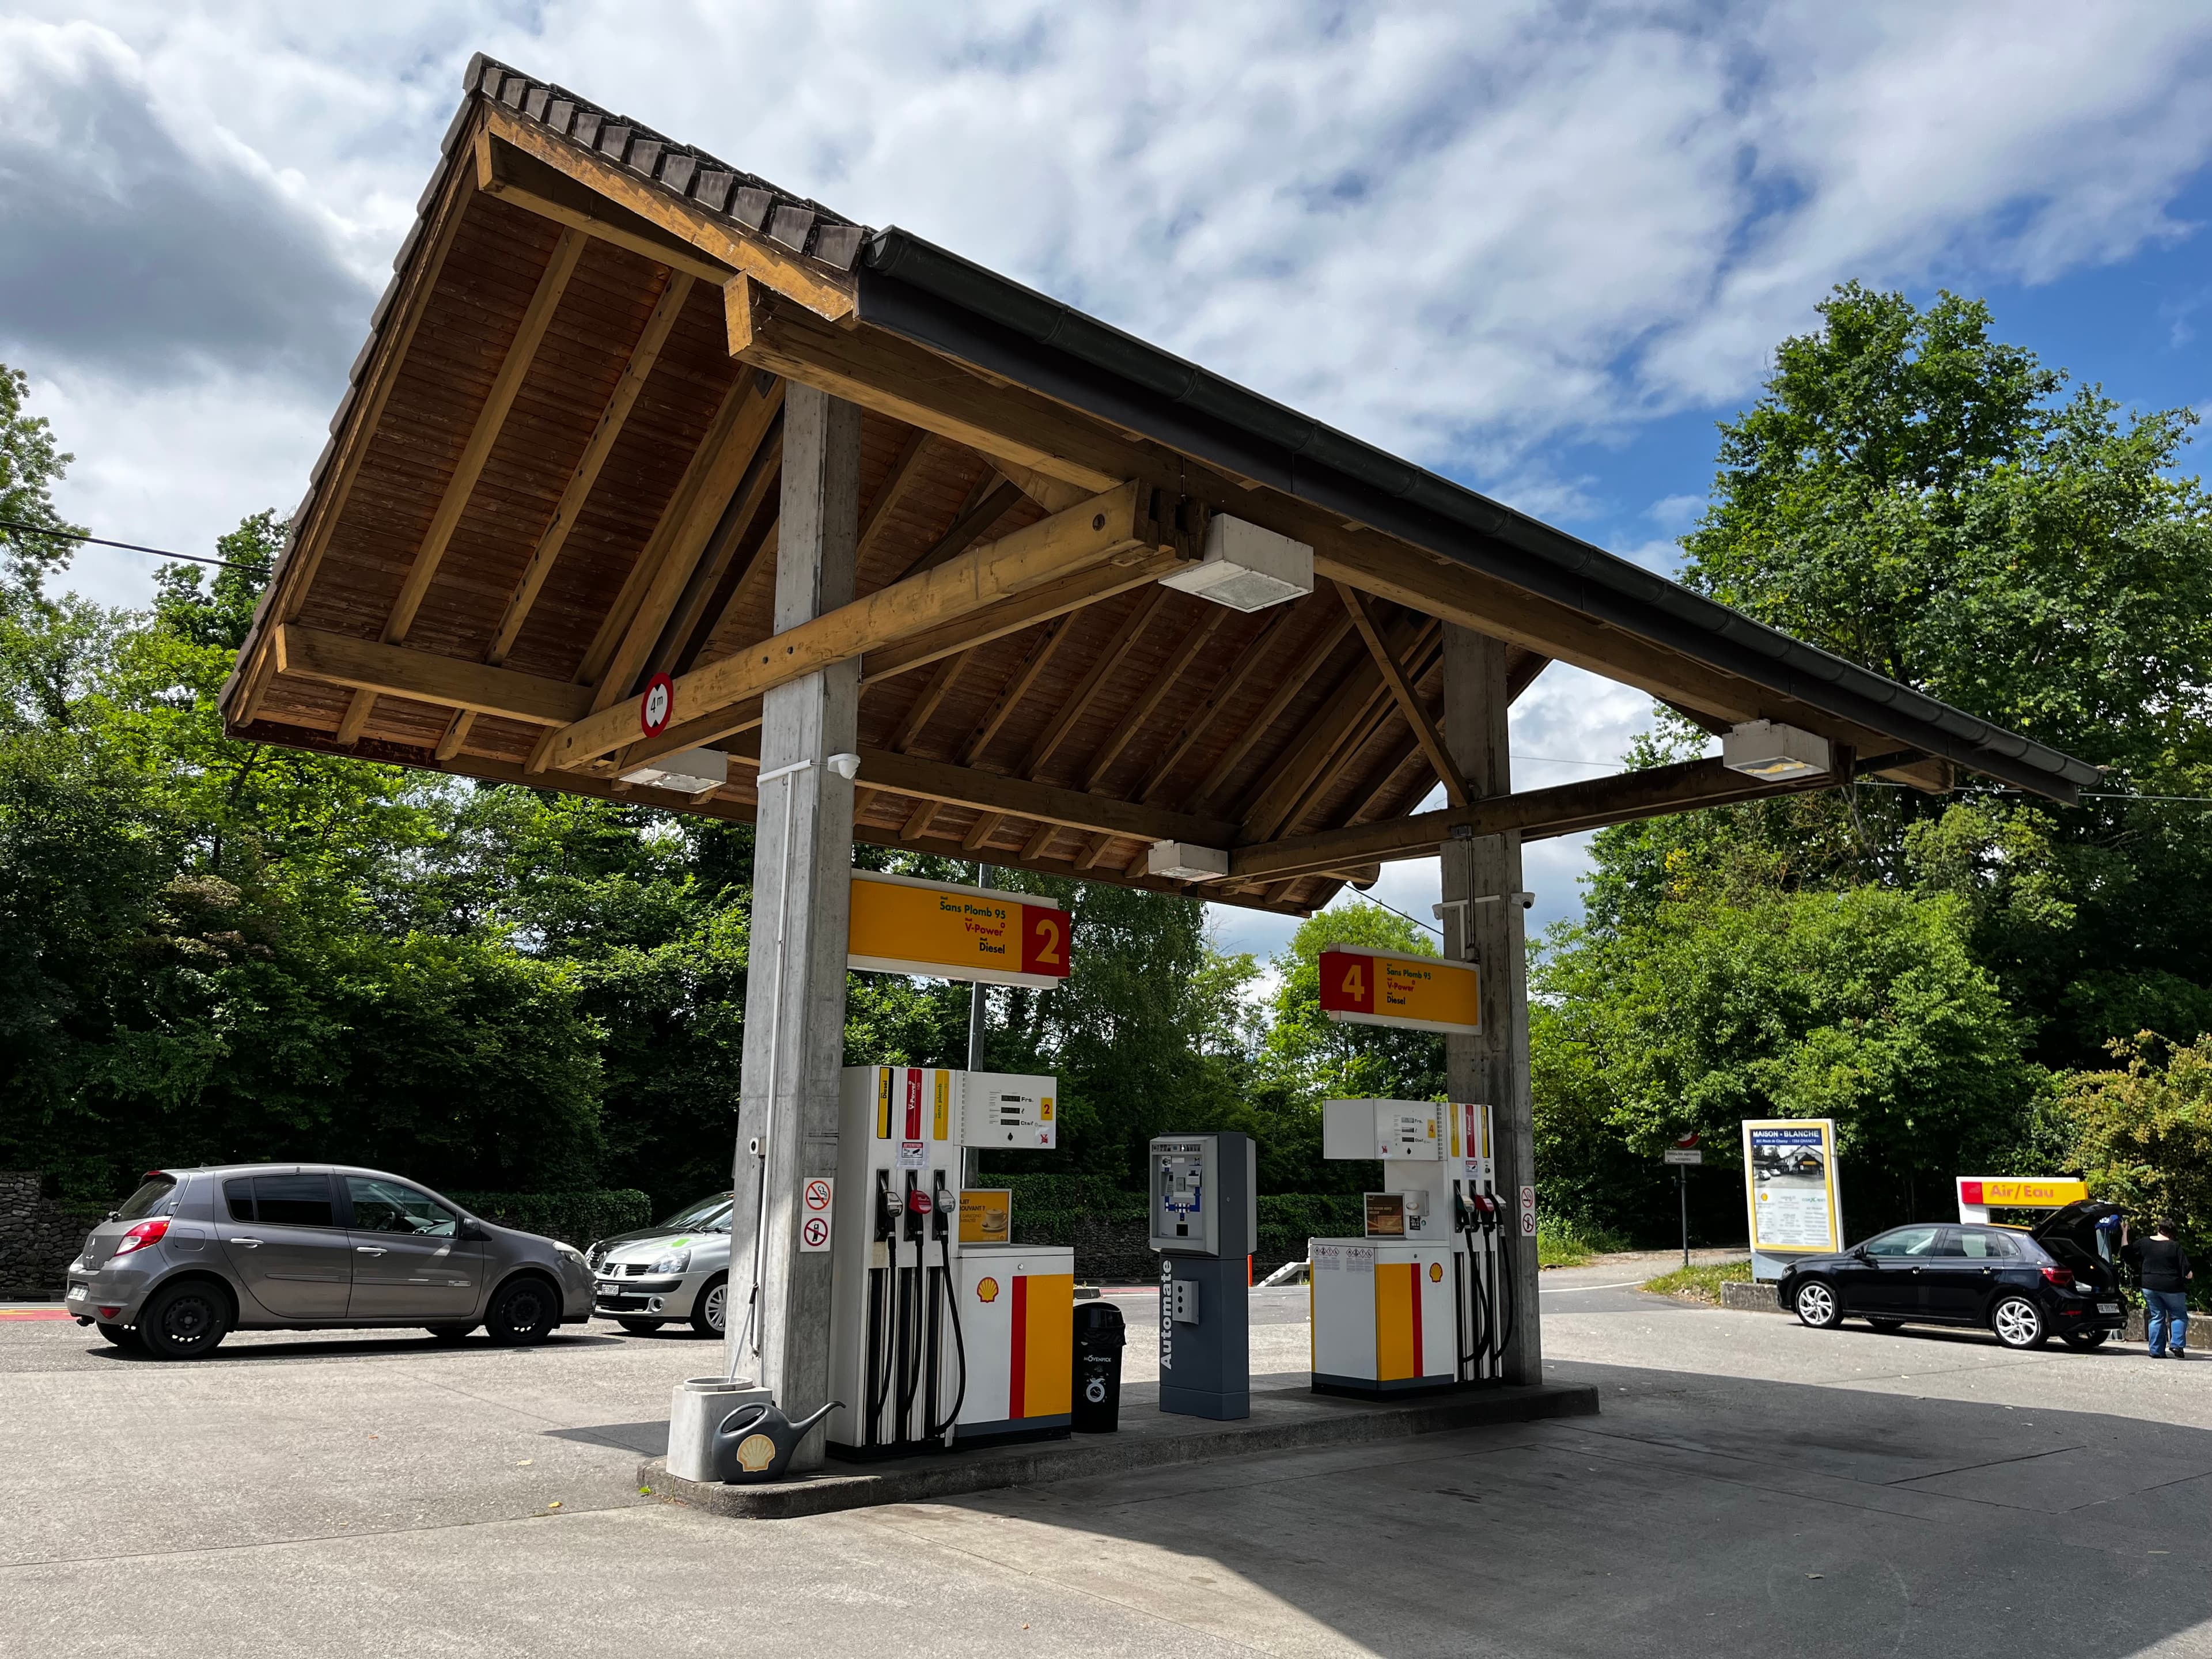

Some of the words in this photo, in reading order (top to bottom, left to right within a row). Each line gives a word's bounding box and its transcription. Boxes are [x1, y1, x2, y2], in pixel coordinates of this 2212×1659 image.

[940, 901, 961, 912] Sans
[964, 904, 992, 918] Plomb
[995, 909, 1006, 919] 95
[965, 923, 1003, 936] V-Power
[979, 942, 1005, 954] Diesel
[1035, 919, 1059, 964] 2
[1387, 967, 1401, 976] Sans
[1403, 969, 1422, 979] Plomb
[1423, 972, 1431, 980] 95
[1342, 964, 1365, 1002] 4
[1387, 981, 1414, 992] V-Power
[1387, 995, 1406, 1005] Diesel
[1044, 1104, 1050, 1114] 2
[1429, 1124, 1434, 1133] 4
[1160, 1260, 1172, 1370] Automate
